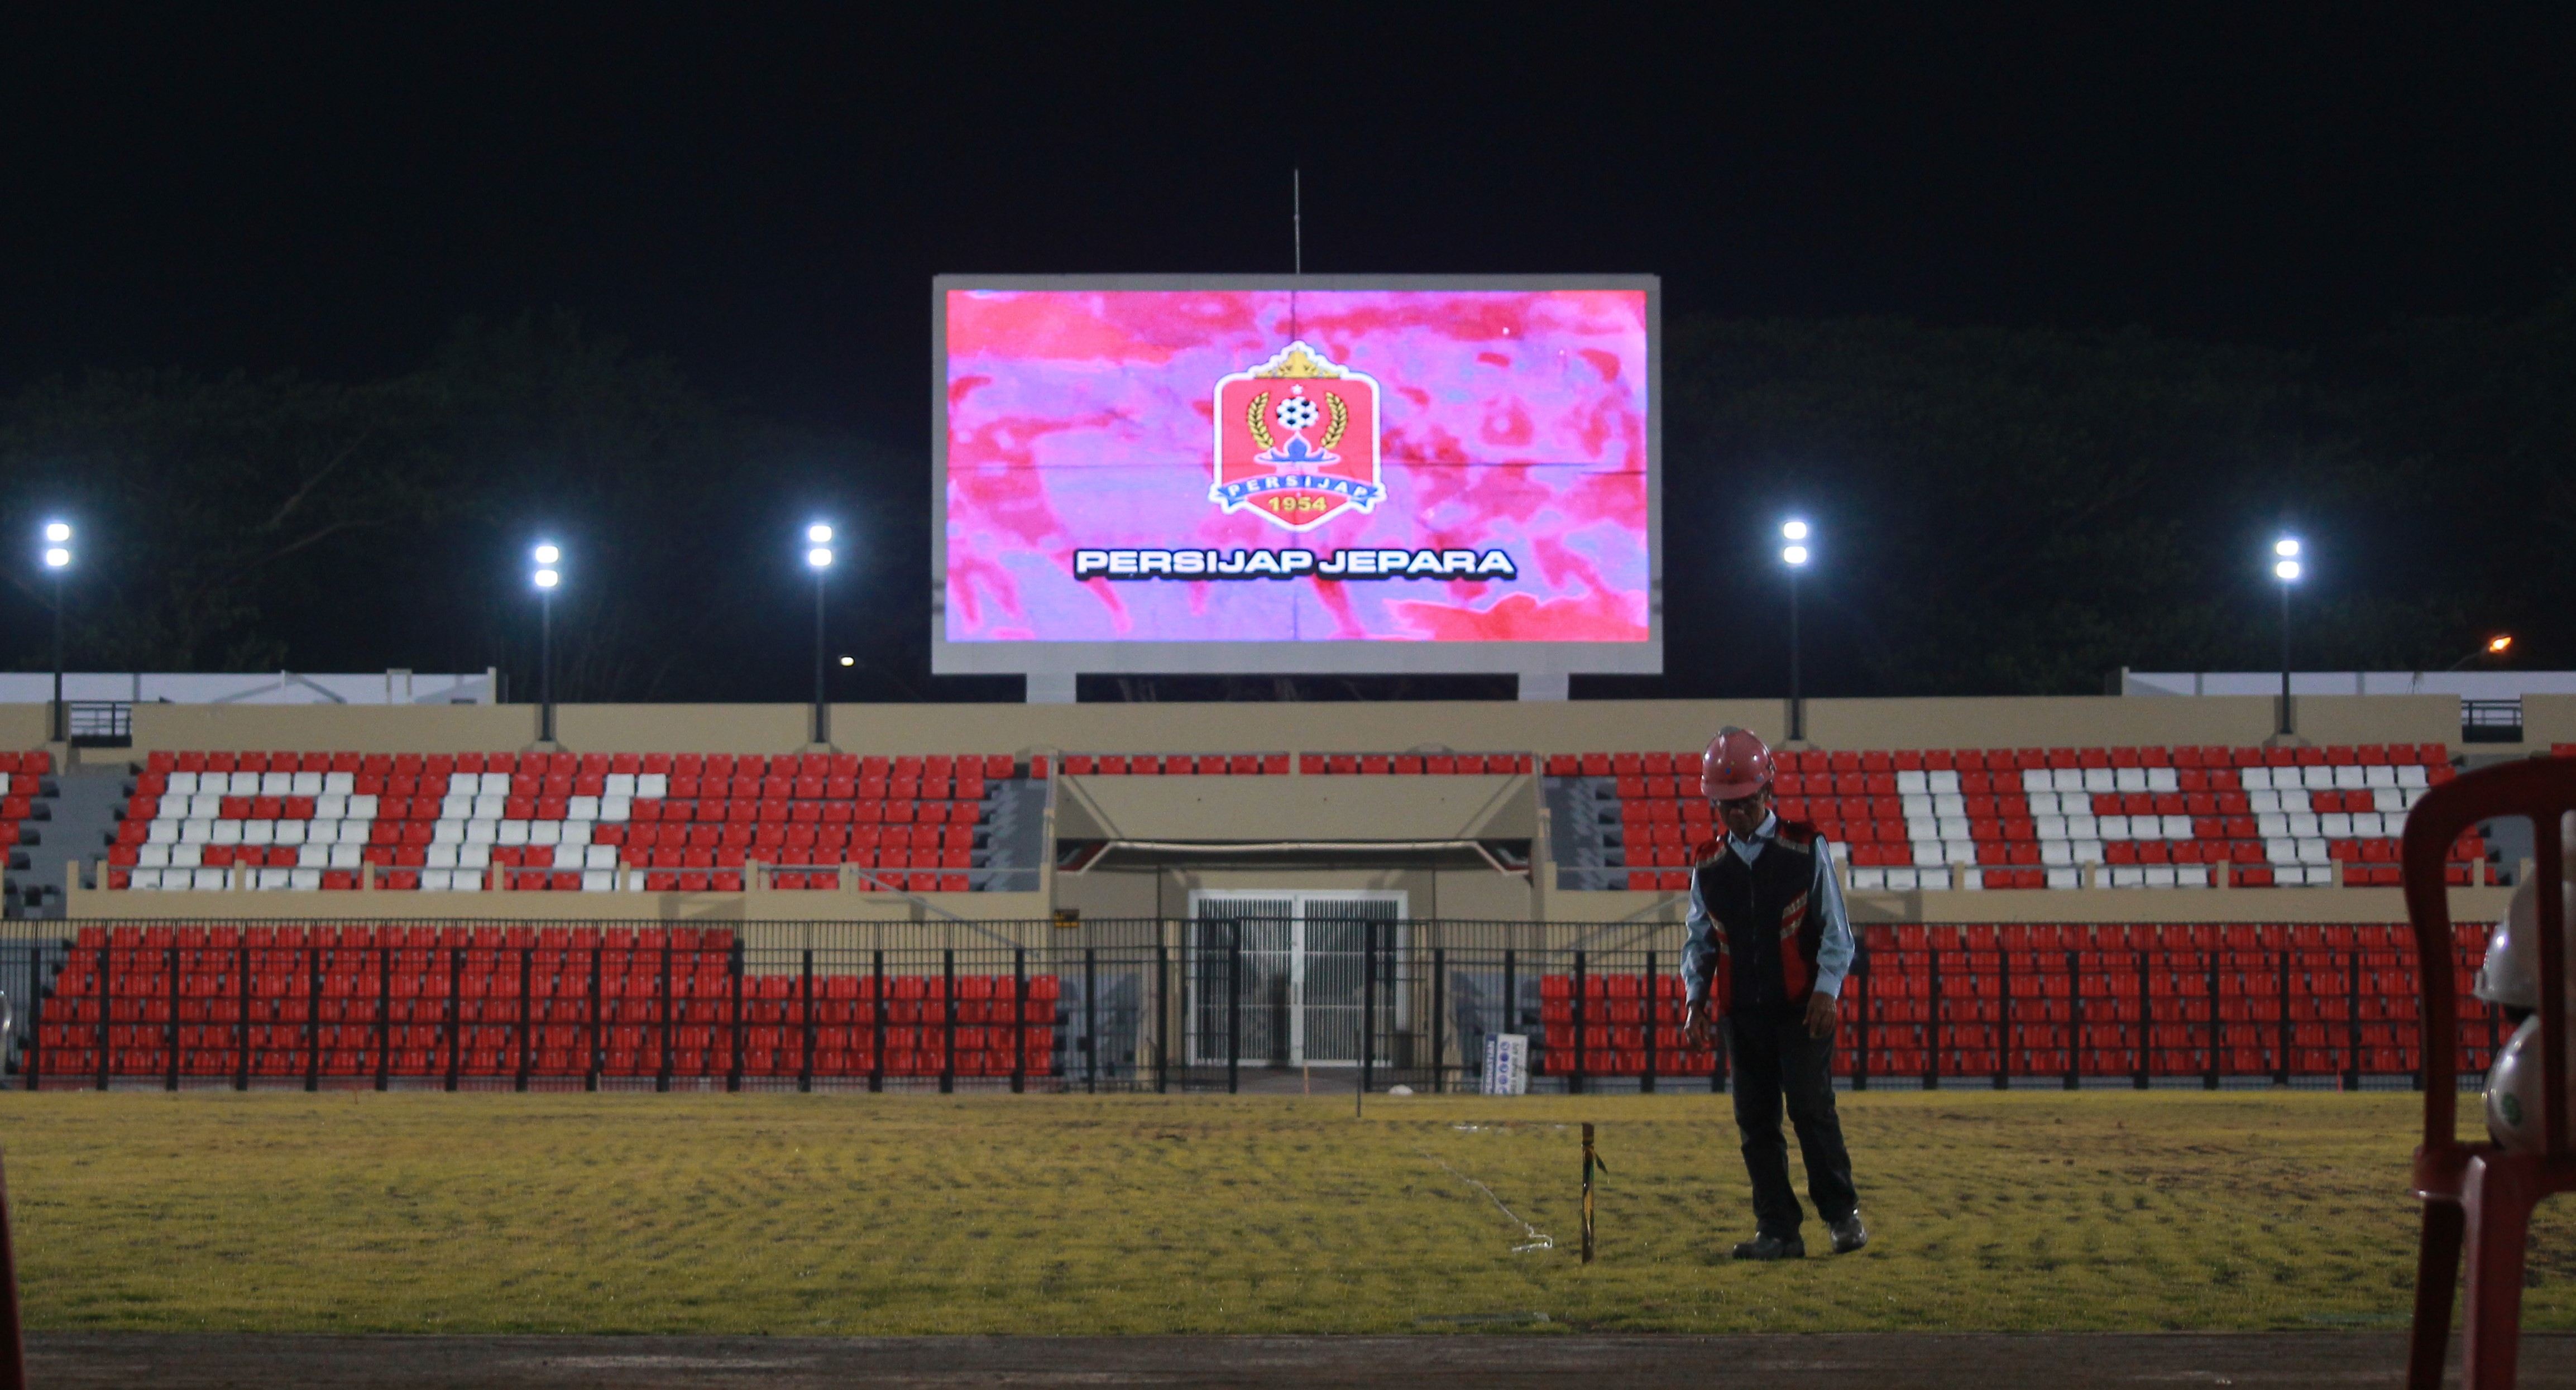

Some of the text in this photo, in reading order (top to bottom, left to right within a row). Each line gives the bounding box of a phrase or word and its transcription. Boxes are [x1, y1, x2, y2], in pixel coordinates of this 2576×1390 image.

[1228, 476, 1368, 497] PERSIJAP
[1268, 496, 1328, 512] 1954
[1076, 549, 1515, 576] PERSIJAP JEPARA
